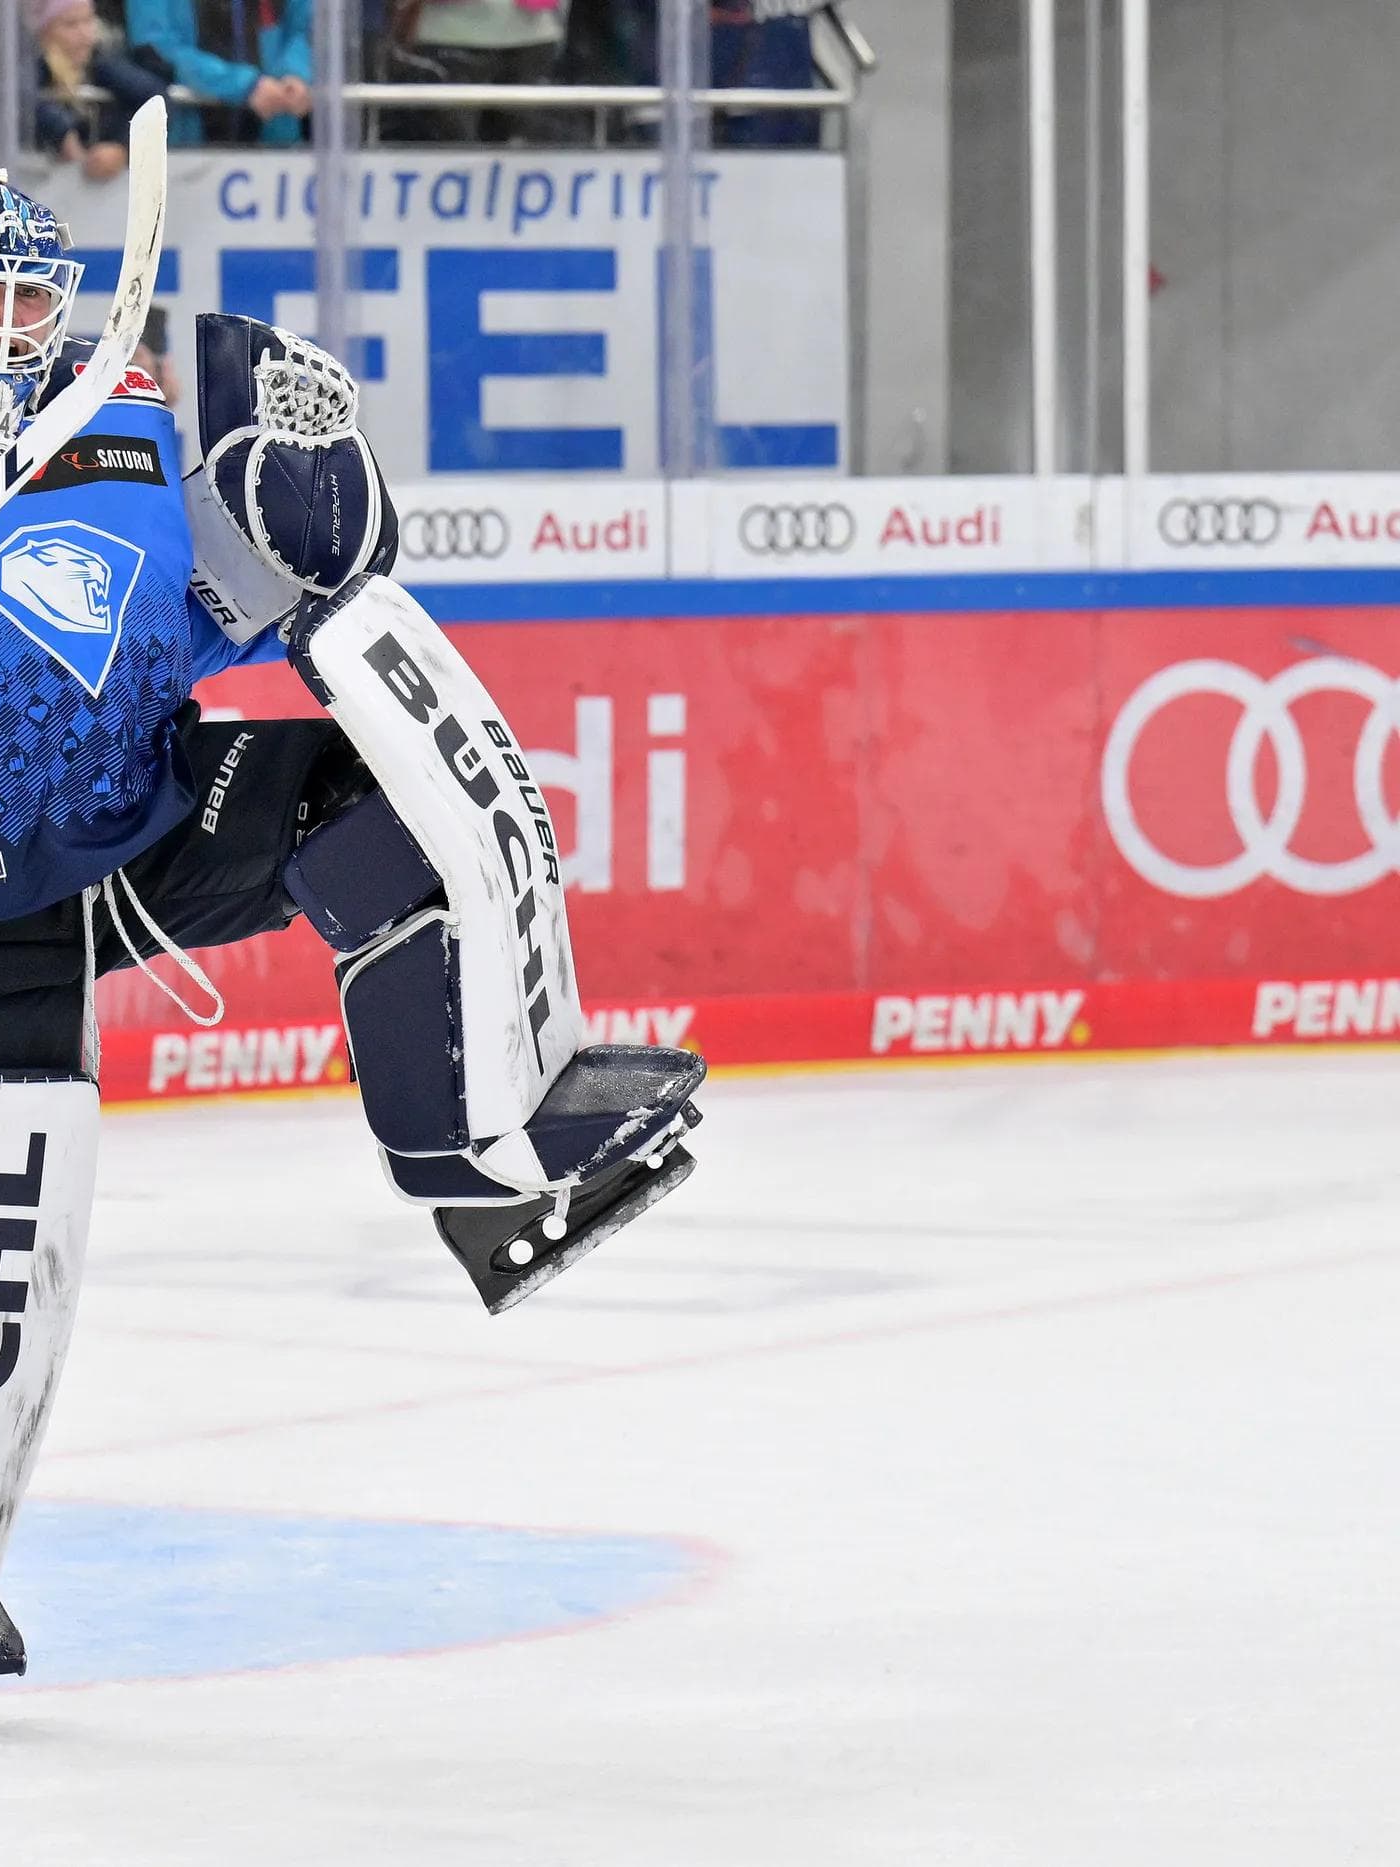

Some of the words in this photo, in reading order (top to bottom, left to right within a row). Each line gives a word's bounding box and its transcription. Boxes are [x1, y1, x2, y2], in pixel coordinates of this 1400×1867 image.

[96, 448, 155, 473] SATURN
[327, 473, 342, 557] HYPERLITE
[530, 511, 648, 553] Audi
[878, 506, 1001, 548] Audi
[1304, 500, 1400, 542] Au
[200, 731, 255, 835] BAUER
